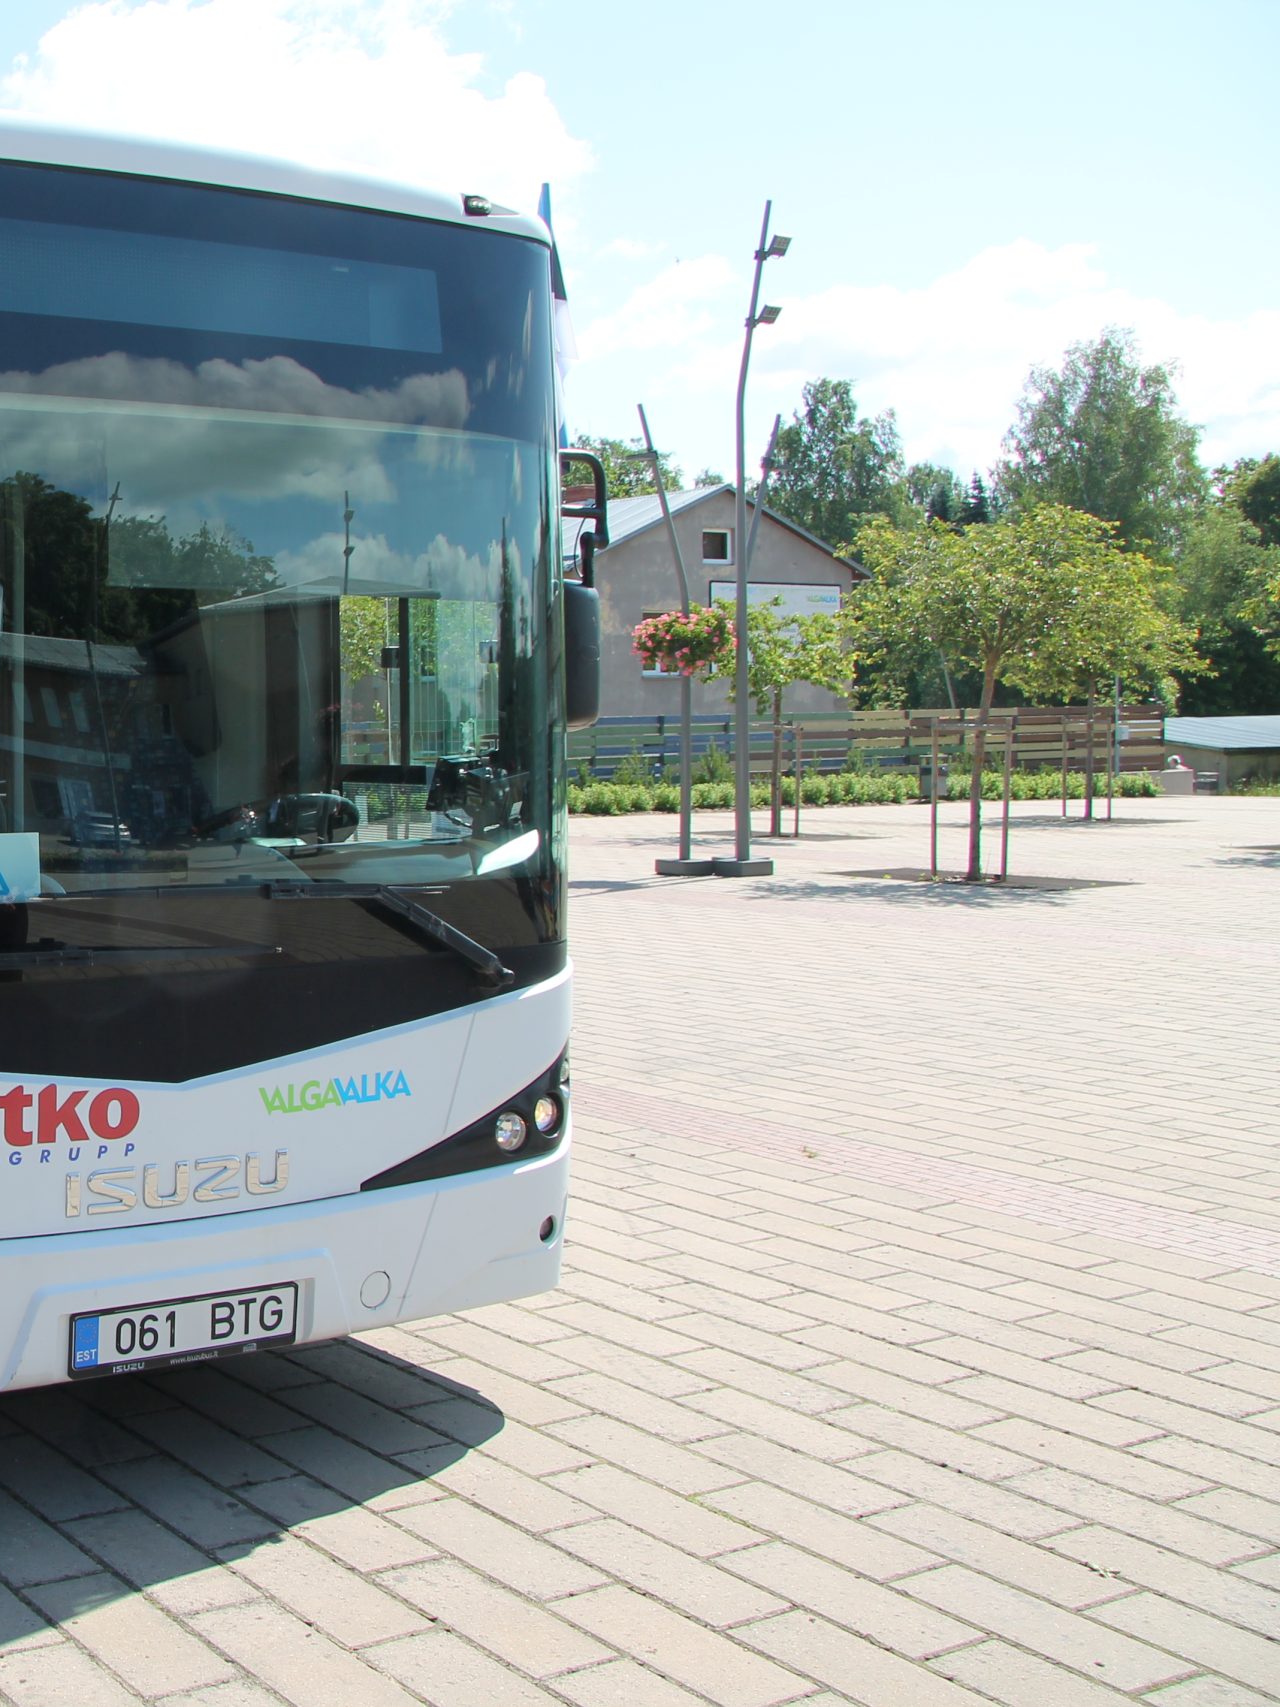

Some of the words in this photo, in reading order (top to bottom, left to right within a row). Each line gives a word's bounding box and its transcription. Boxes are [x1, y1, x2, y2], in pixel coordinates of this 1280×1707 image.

[8, 1143, 134, 1166] GRUPP
[66, 1148, 288, 1217] ISUZU
[116, 1310, 176, 1354] 061
[211, 1296, 283, 1340] BTG
[76, 1348, 97, 1362] EST
[112, 1362, 144, 1373] ISUZU
